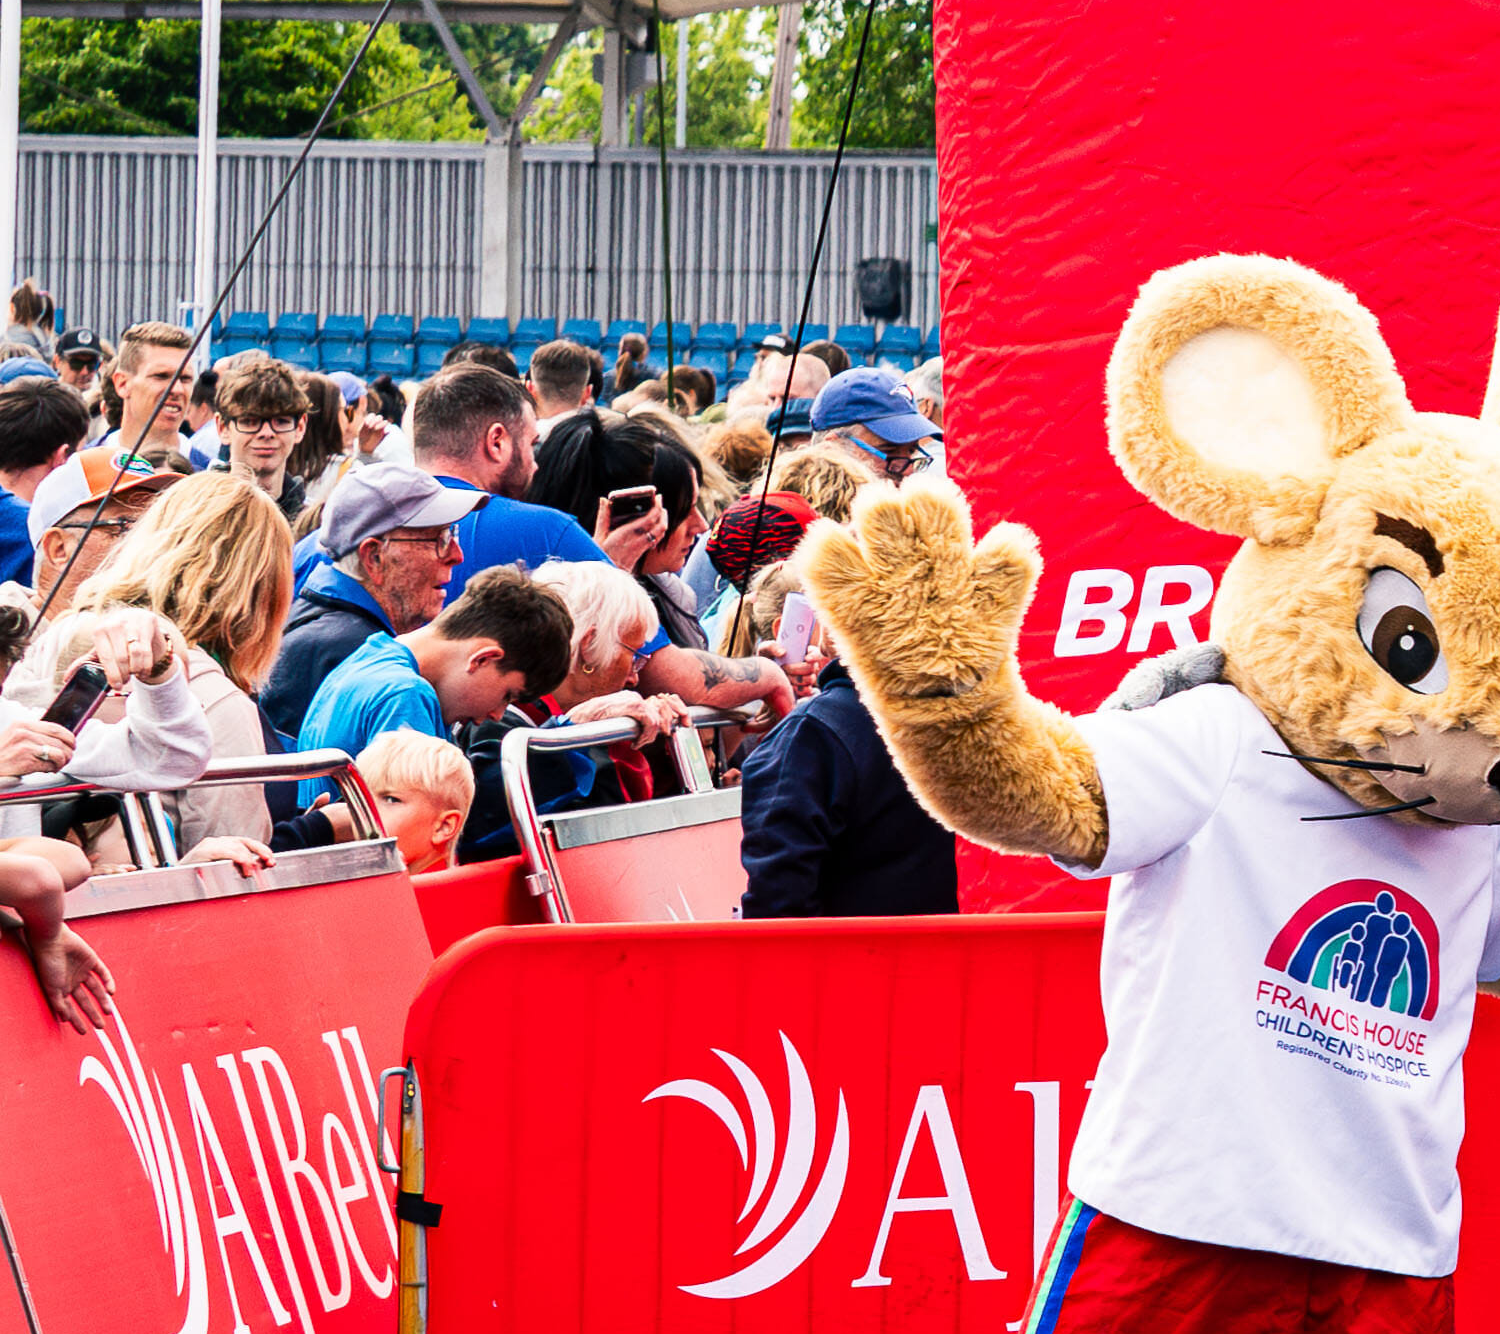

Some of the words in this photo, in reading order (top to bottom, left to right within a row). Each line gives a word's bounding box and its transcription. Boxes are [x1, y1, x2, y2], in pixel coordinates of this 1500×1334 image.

[1256, 1010, 1364, 1061] CHILDREN'S
[1368, 1049, 1431, 1077] HOSPICE
[1257, 980, 1359, 1036] FRANCIS
[1363, 1019, 1427, 1056] HOUSE
[1276, 1039, 1331, 1065] Registered
[1333, 1061, 1368, 1081] Charity
